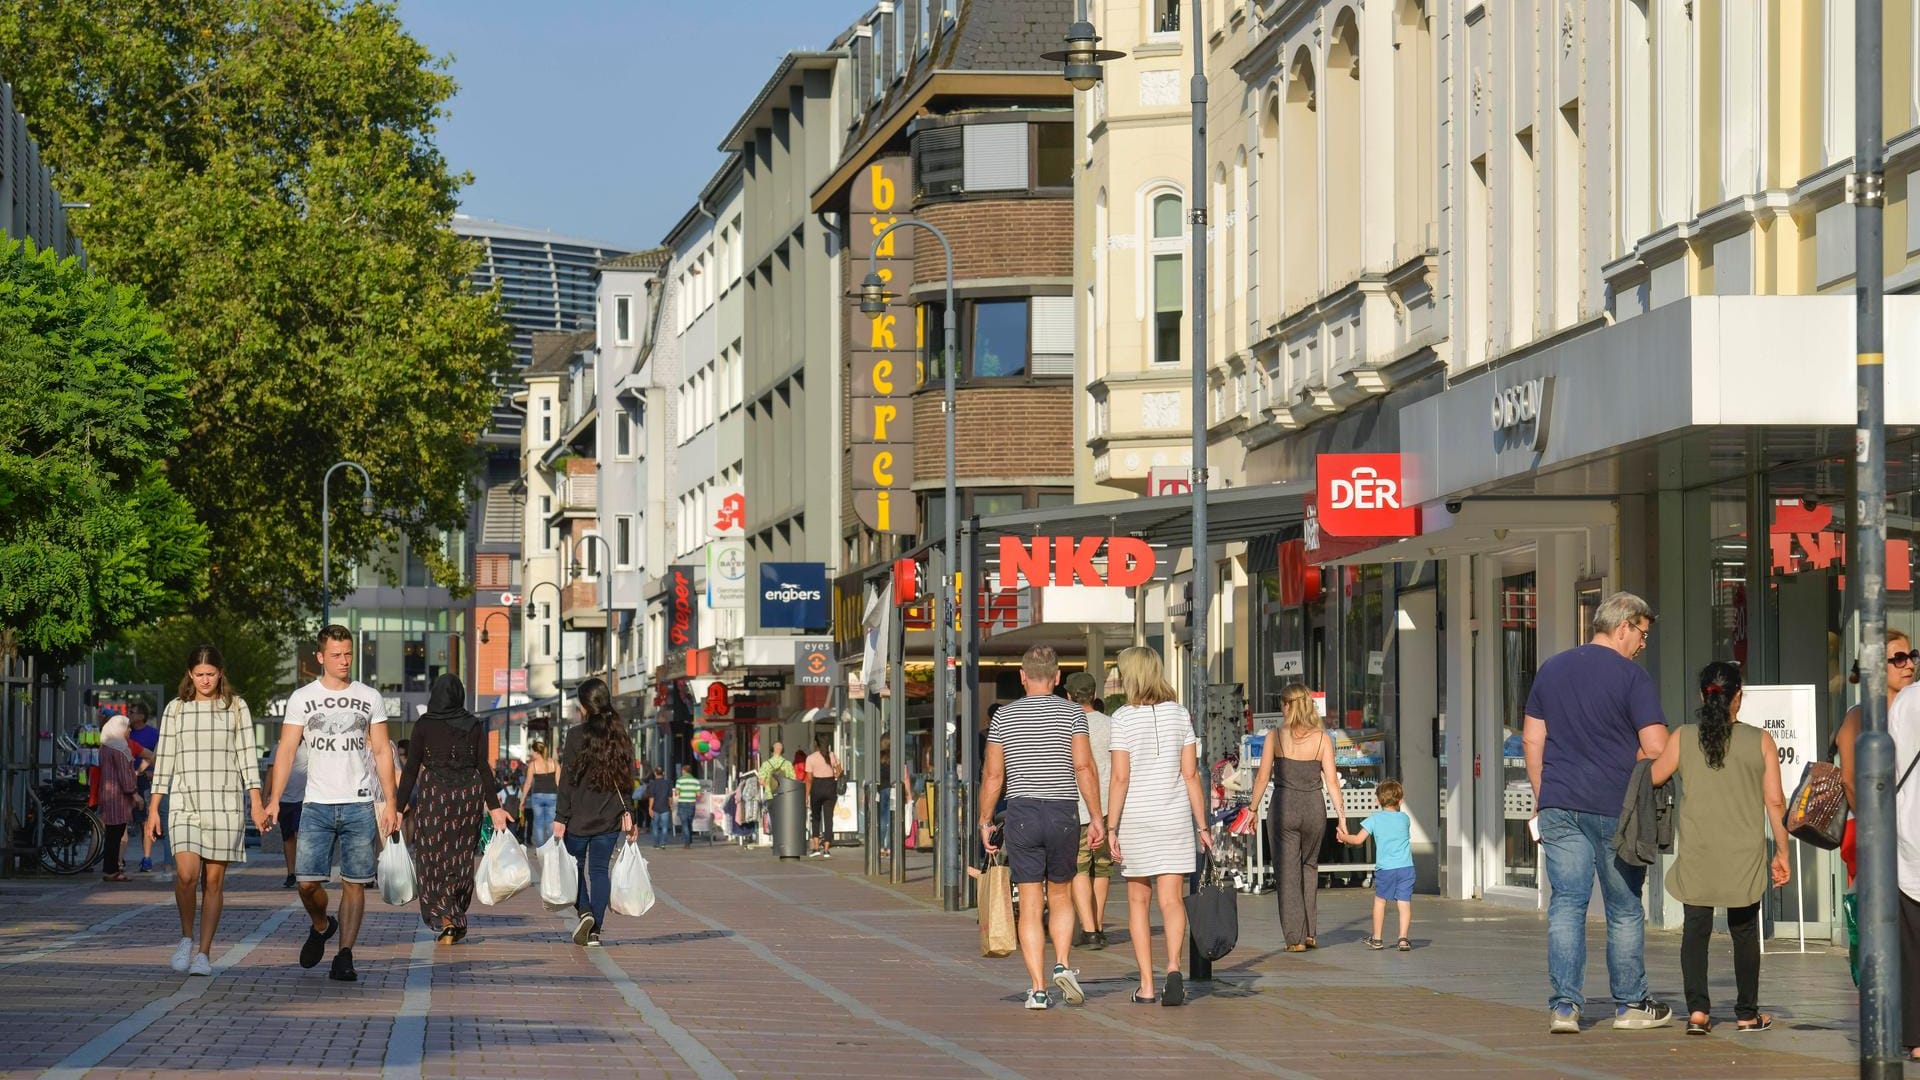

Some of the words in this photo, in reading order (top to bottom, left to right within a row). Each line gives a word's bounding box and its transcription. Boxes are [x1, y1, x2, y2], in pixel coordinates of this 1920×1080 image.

[1331, 478, 1400, 509] DER
[999, 535, 1156, 587] NKD
[765, 589, 821, 603] engbers
[671, 571, 690, 645] Pieper
[804, 642, 830, 652] eyes
[748, 679, 781, 690] engbers
[802, 675, 832, 684] more
[303, 697, 372, 715] JI-CORE
[1763, 719, 1786, 729] JEANS
[1780, 729, 1797, 739] DEAL
[311, 737, 336, 751] JCK
[342, 737, 364, 751] JNS
